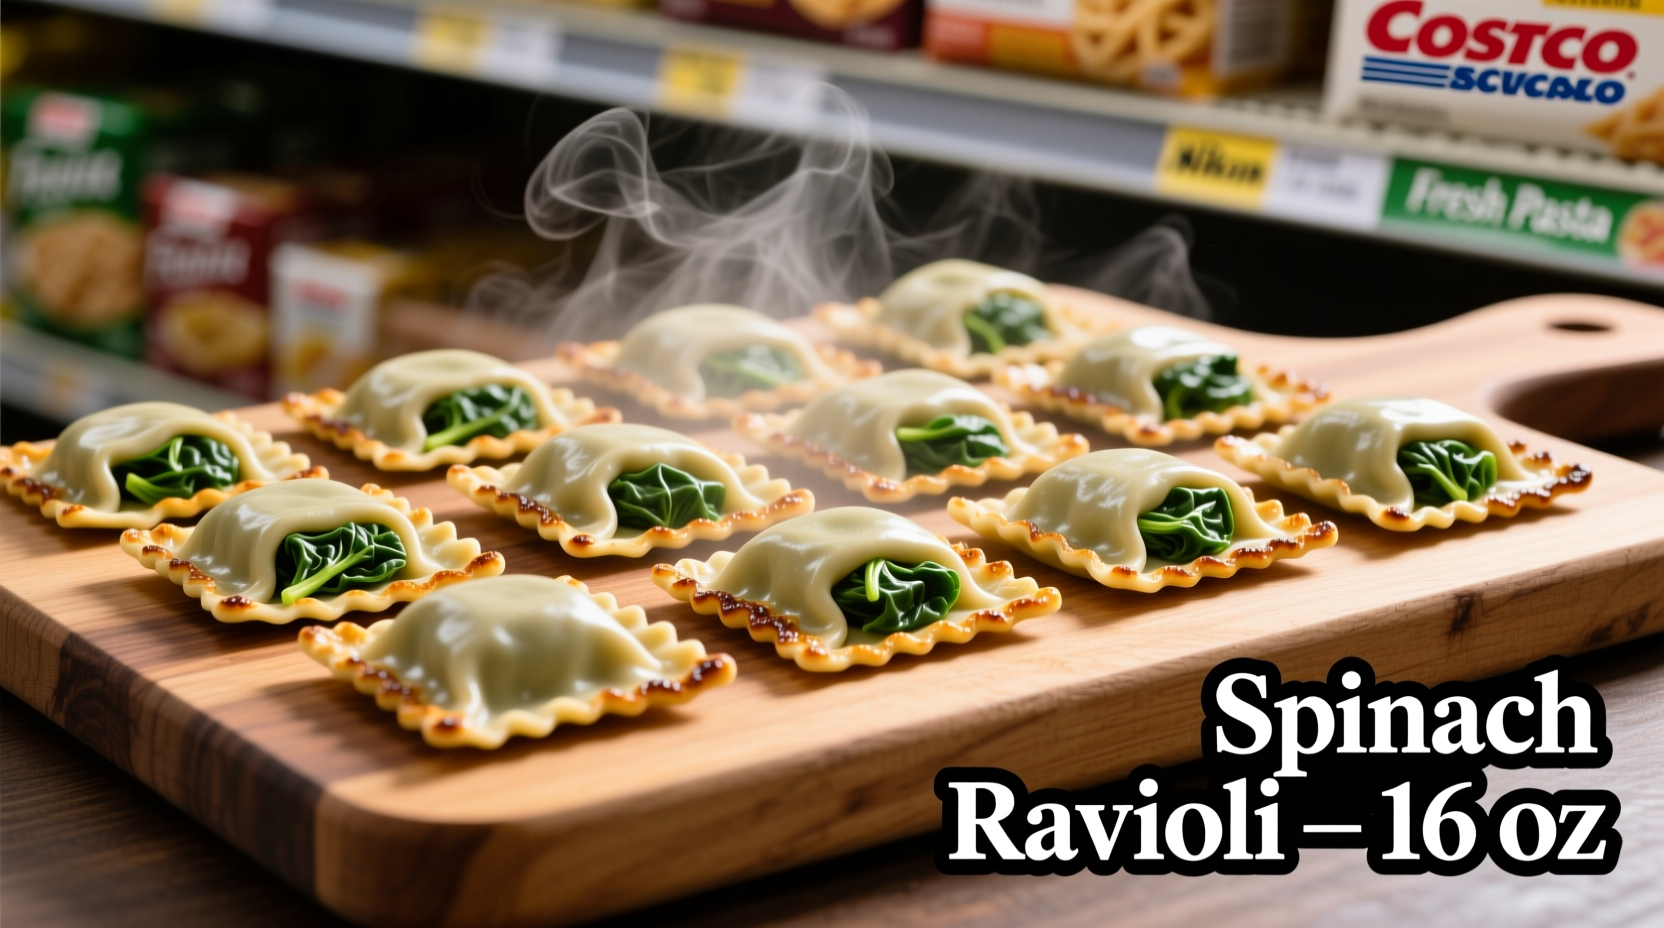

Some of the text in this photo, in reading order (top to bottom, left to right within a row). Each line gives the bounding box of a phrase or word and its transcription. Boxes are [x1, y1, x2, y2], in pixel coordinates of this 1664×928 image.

[1366, 0, 1639, 75] COSTCO
[1404, 167, 1614, 243] Fresh Pasta
